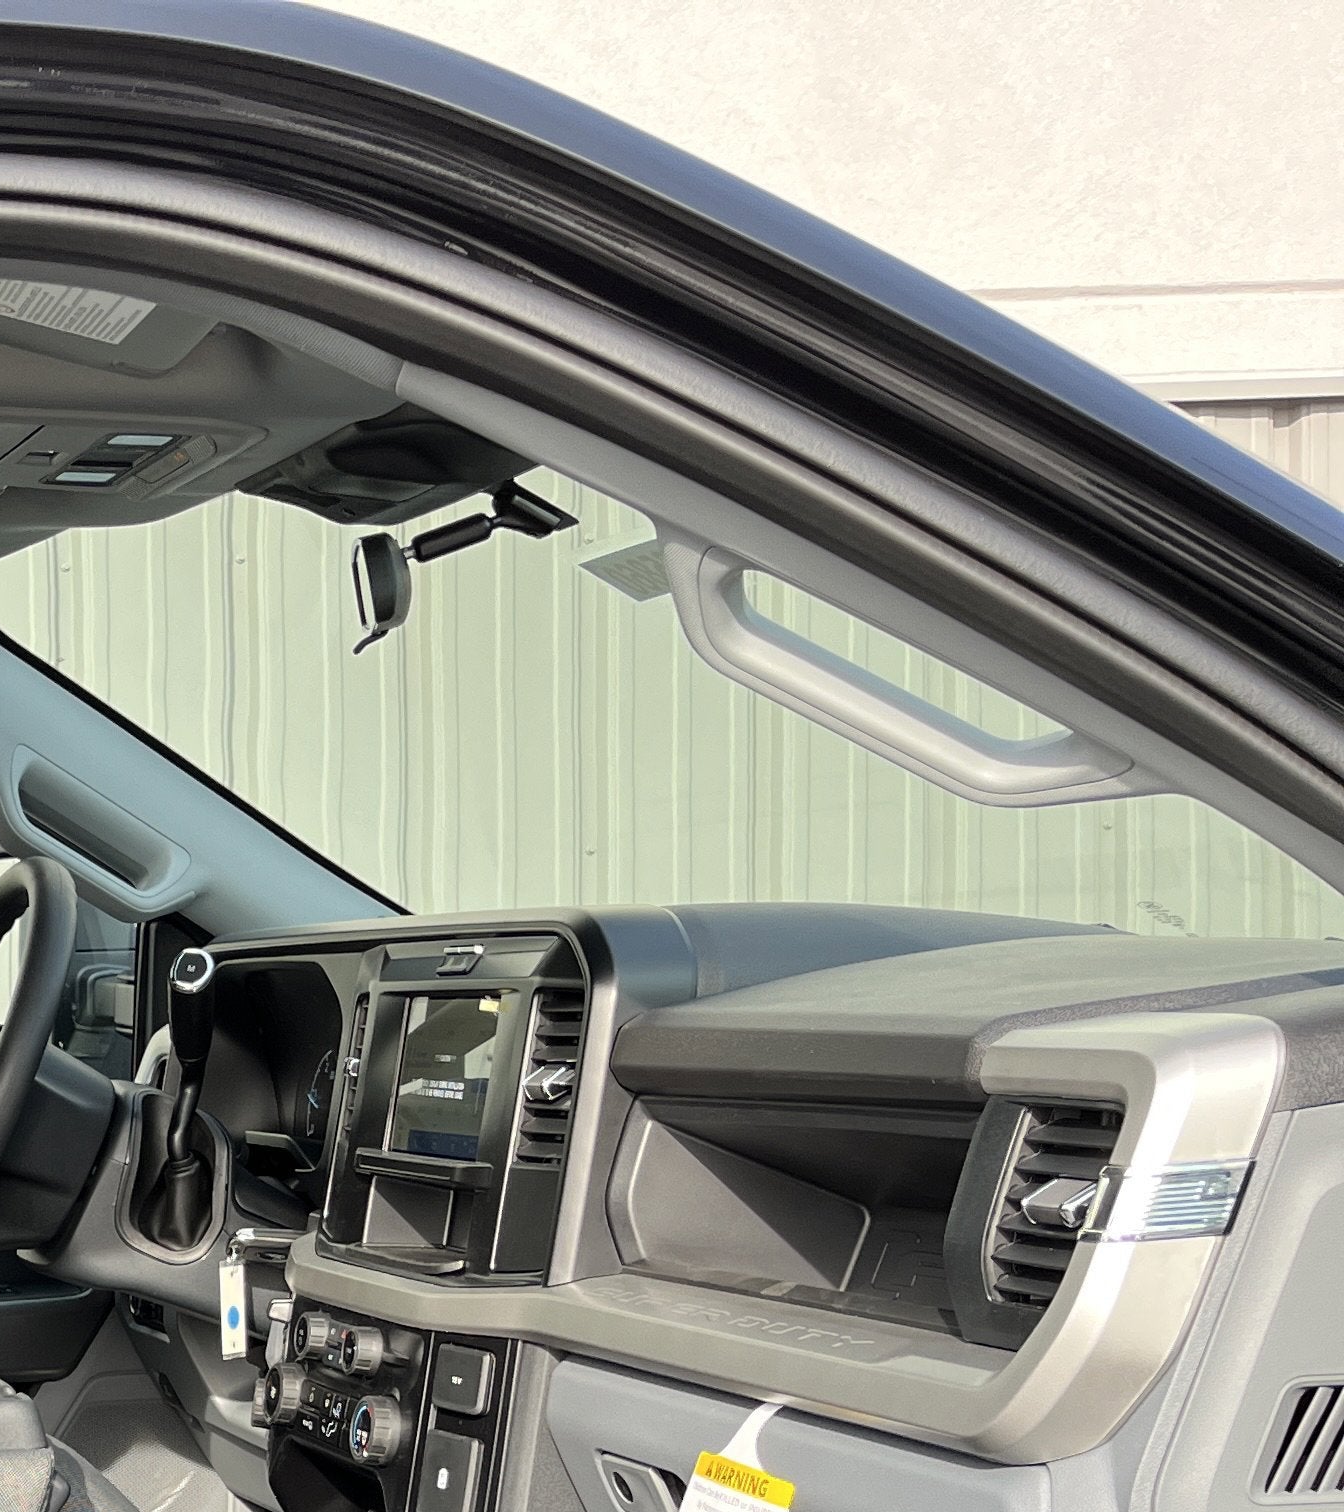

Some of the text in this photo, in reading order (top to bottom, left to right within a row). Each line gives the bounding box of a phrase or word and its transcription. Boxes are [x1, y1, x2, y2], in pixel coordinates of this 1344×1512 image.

[591, 1287, 875, 1349] SUPER DUTY
[713, 1463, 770, 1498] WARNING
